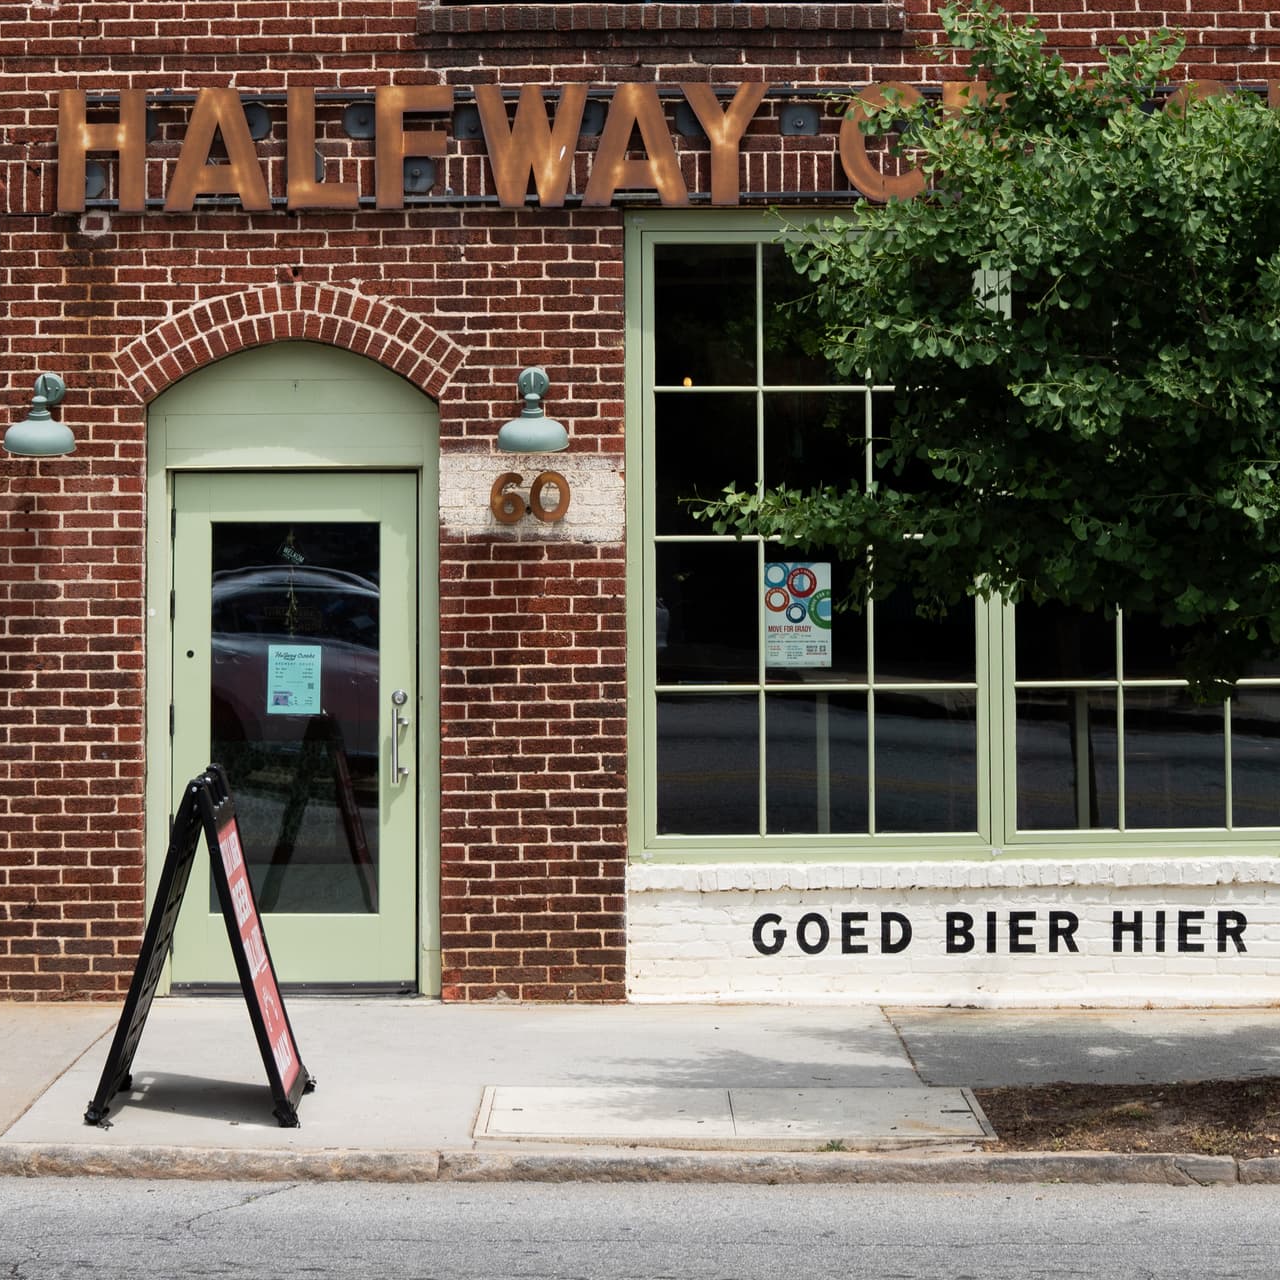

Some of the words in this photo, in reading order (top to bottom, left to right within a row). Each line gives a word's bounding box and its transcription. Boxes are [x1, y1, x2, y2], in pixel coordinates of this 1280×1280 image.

[57, 81, 770, 212] HALFWAY
[490, 471, 570, 526] 60
[768, 625, 783, 633] MOVE
[784, 625, 794, 633] FOR
[795, 625, 812, 633] GRADY
[751, 911, 913, 956] GOED
[945, 910, 1081, 954] BIER
[1112, 909, 1248, 953] HIER
